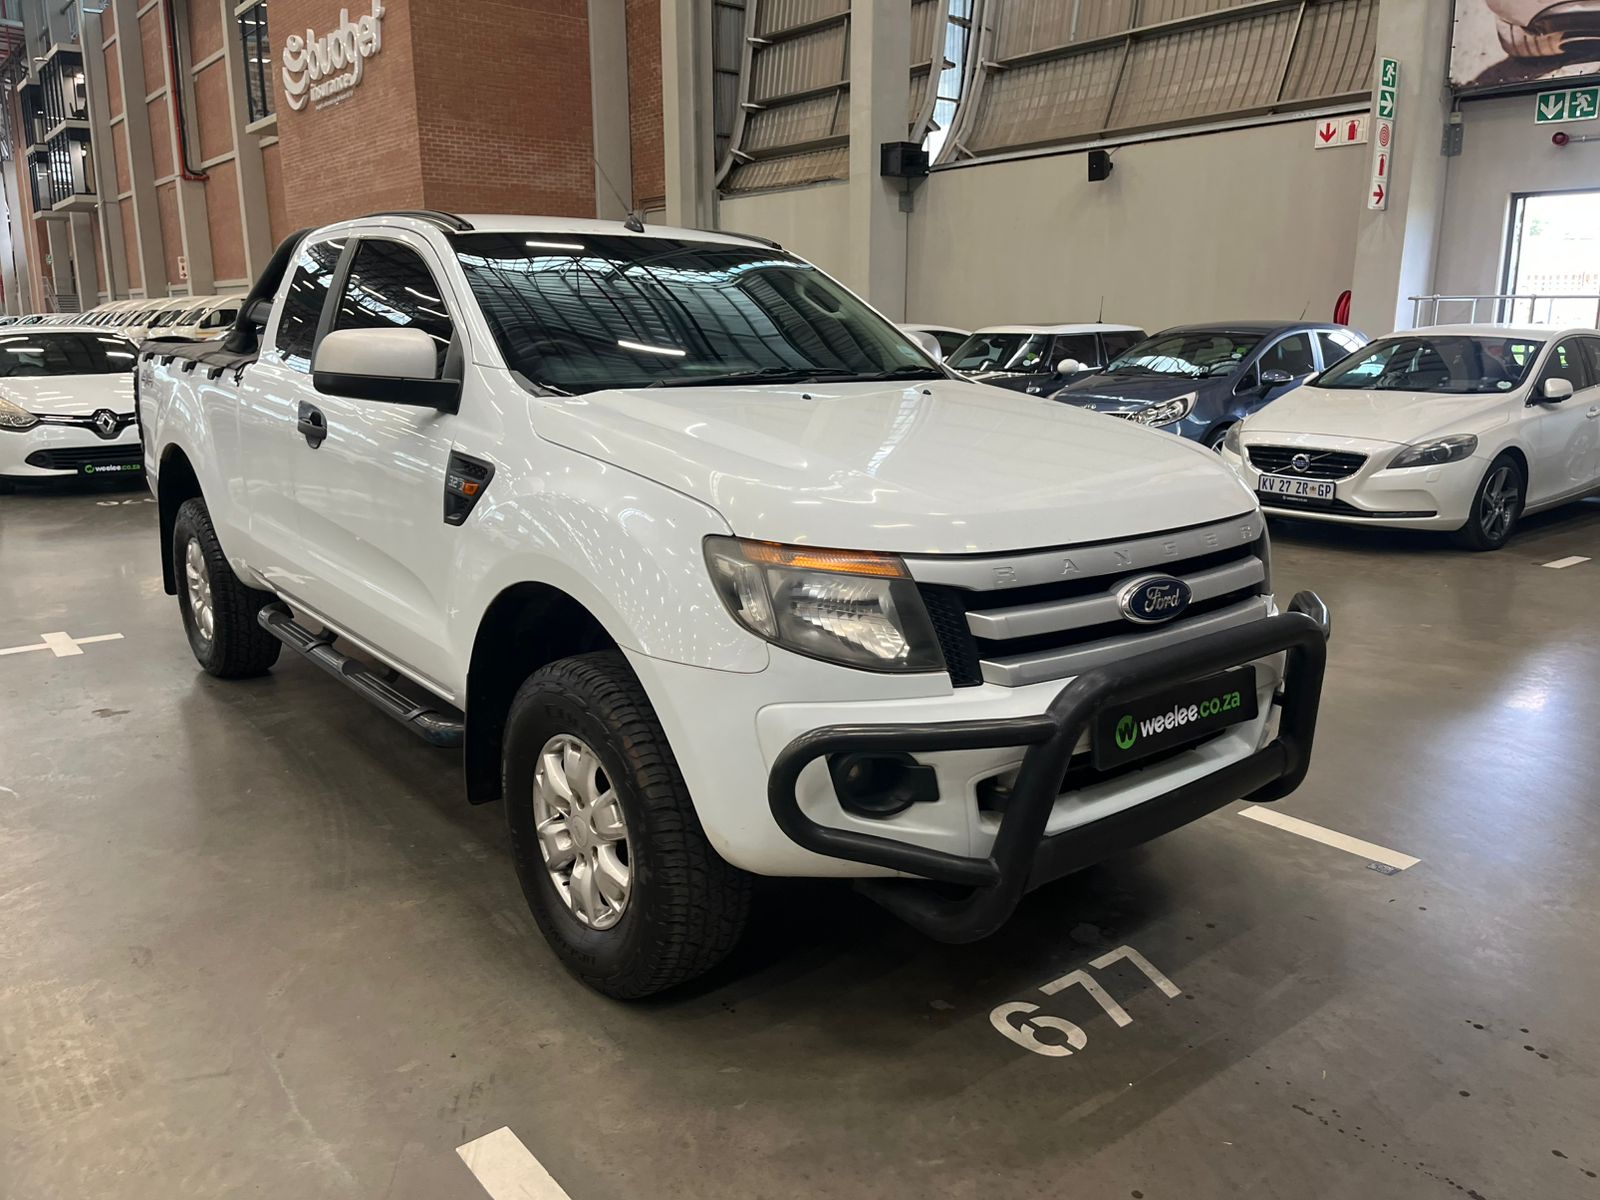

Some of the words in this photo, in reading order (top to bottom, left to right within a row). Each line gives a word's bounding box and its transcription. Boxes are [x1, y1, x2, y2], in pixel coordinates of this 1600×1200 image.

[306, 0, 385, 88] budget
[95, 464, 141, 472] weelee.co.za
[1262, 478, 1275, 490] KV
[1279, 480, 1291, 492] 27
[1296, 482, 1308, 495] ZR
[1318, 484, 1331, 497] GP
[992, 524, 1252, 584] RANGER
[1144, 584, 1180, 613] Ford
[1140, 691, 1240, 738] weelee.co.za
[989, 944, 1182, 1057] 677
